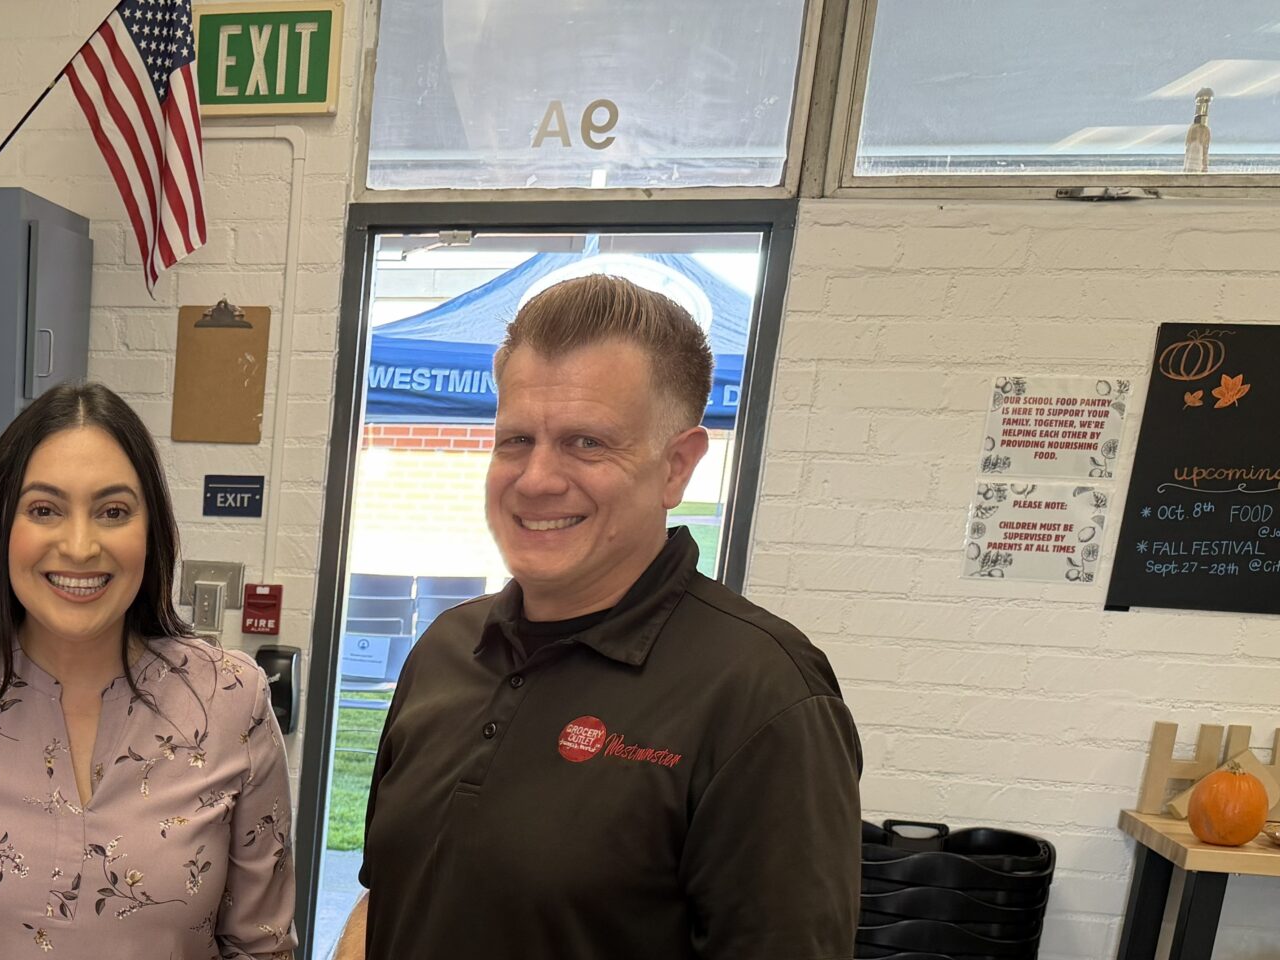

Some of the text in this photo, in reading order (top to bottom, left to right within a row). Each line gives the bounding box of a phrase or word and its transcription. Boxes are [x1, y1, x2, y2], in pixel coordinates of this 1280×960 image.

[216, 22, 319, 96] EXIT
[1003, 396, 1112, 408] OUR SCHOOL FOOD PANTRY
[1002, 407, 1110, 418] IS HERE TO SUPPORT YOUR
[1002, 417, 1105, 430] FAMILY. TOGETHER, WE'RE
[1002, 428, 1101, 440] HELPING EACH OTHER BY
[1000, 439, 1098, 451] PROVIDING NOURISHING
[1033, 451, 1058, 461] FOOD.
[216, 492, 252, 508] EXIT
[1013, 500, 1068, 511] PLEASE NOTE:
[1192, 501, 1215, 518] 8th
[1229, 505, 1273, 523] FOOD
[999, 521, 1074, 532] CHILDREN MUST BE
[1003, 532, 1066, 542] SUPERVISED BY
[987, 542, 1076, 554] PARENTS AT ALL TIMES
[1152, 541, 1266, 556] FALL FESTIVAL
[246, 618, 276, 629] FIRE
[566, 724, 605, 739] GROCERY
[568, 734, 595, 746] OUTLET
